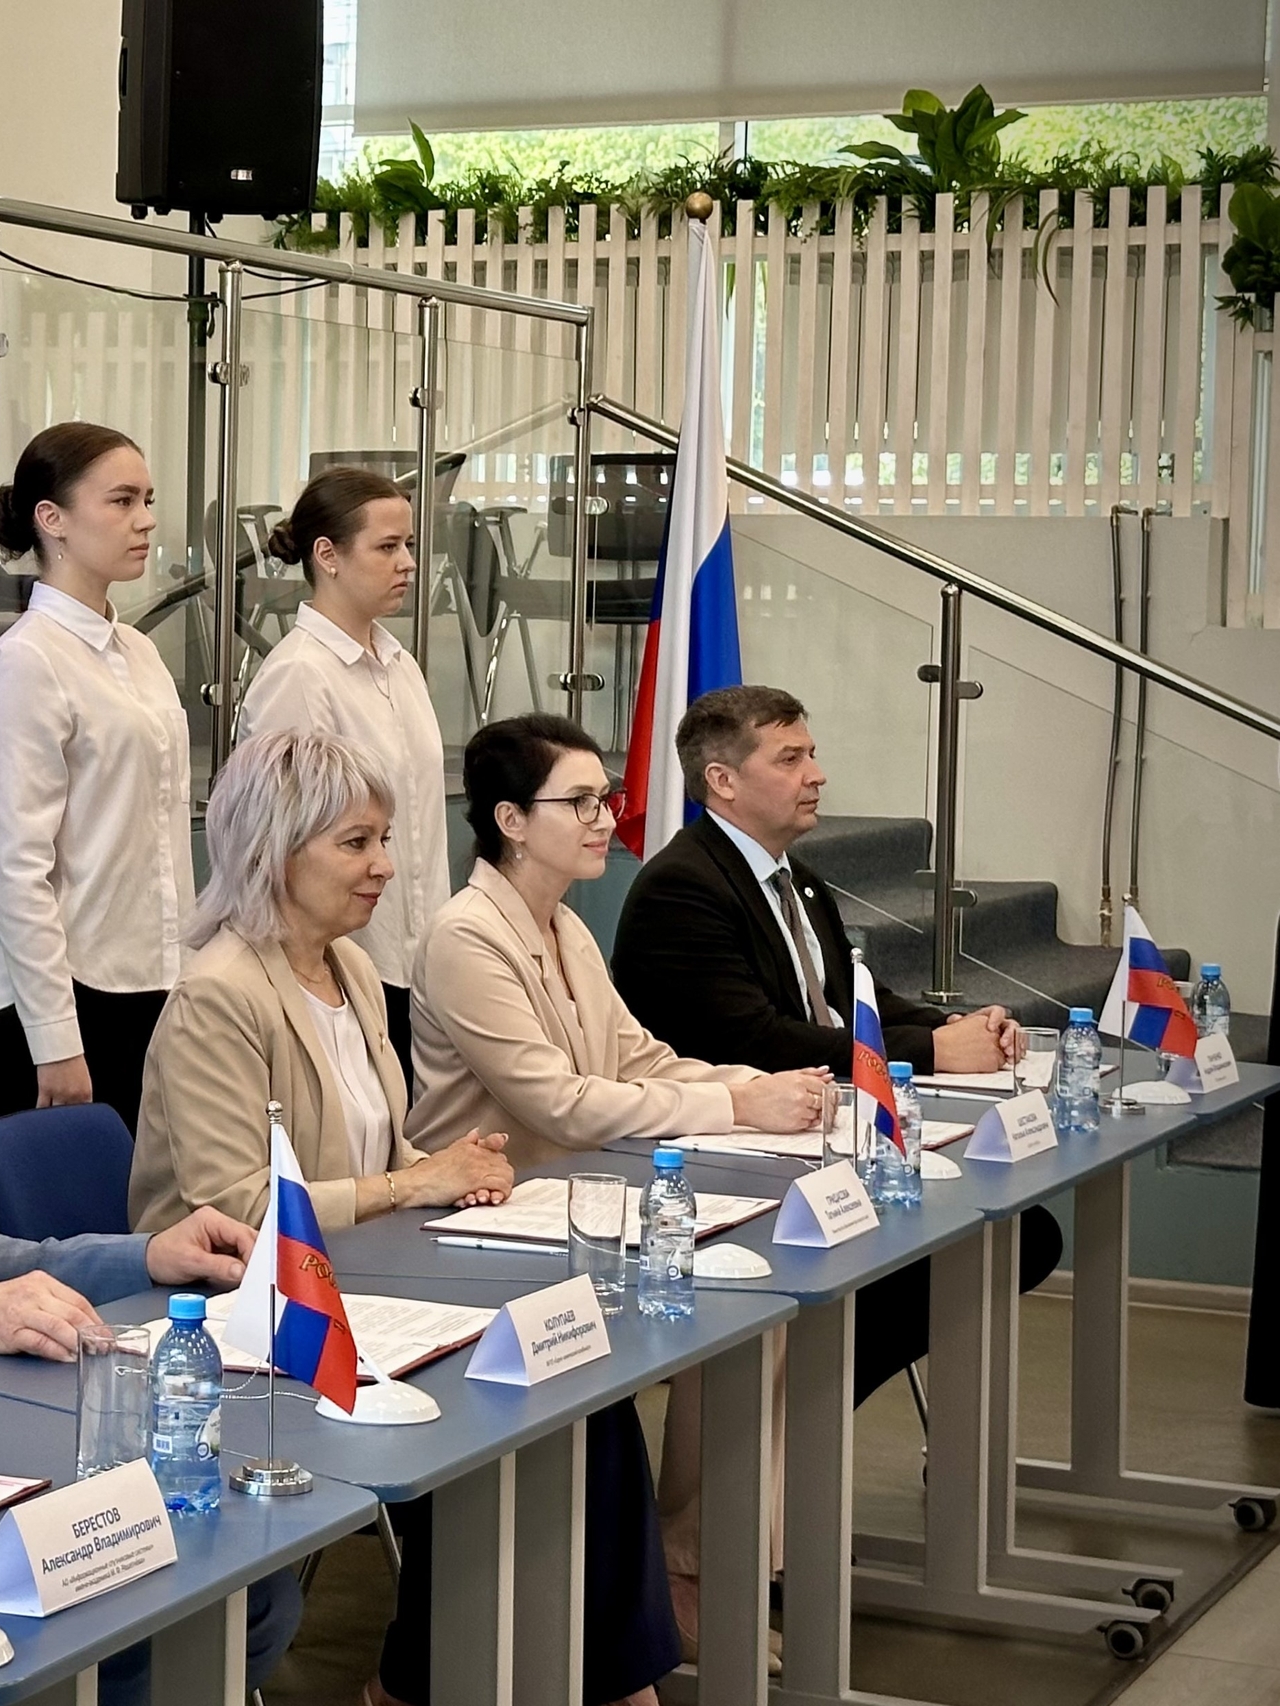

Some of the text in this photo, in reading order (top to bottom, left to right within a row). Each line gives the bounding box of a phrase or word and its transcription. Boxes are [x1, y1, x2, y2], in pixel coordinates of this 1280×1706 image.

[543, 1309, 576, 1331] КОЛУПАЕВ
[531, 1332, 559, 1356] Дмитрий
[557, 1320, 597, 1343] Никифорович
[71, 1507, 121, 1539] БЕРЕСТОВ
[41, 1515, 162, 1575] Александр Владимирович
